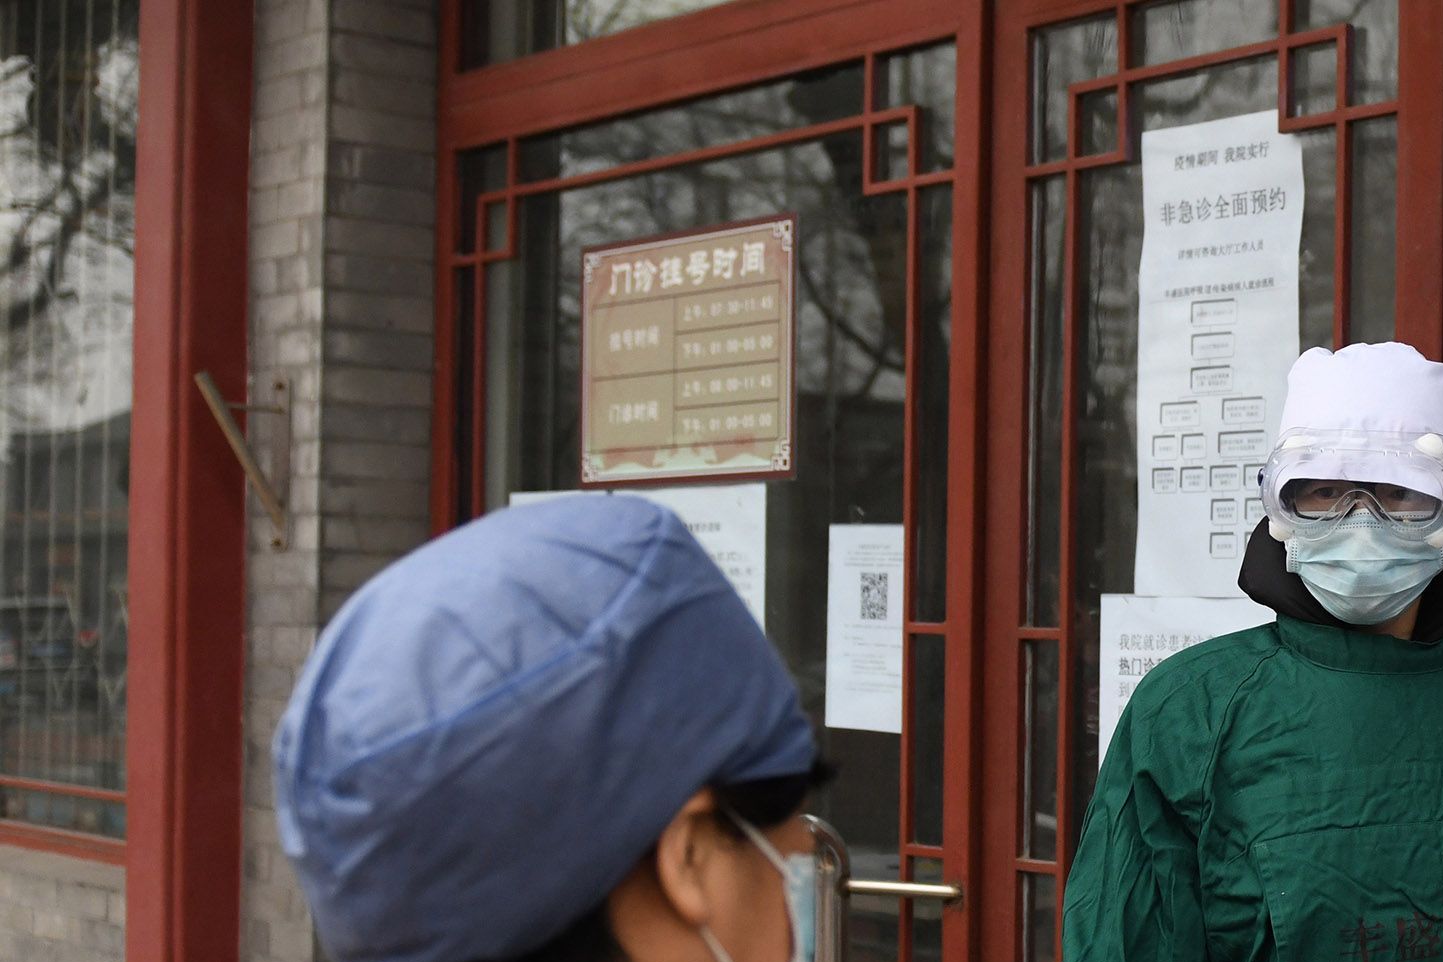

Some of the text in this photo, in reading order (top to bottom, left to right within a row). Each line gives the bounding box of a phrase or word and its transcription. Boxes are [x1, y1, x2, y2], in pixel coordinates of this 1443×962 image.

[1161, 188, 1285, 226] 非急诊全面预约
[610, 243, 764, 294] 门诊挂号时间
[1119, 633, 1215, 652] 我院就诊患者
[1119, 656, 1164, 676] 热门诊
